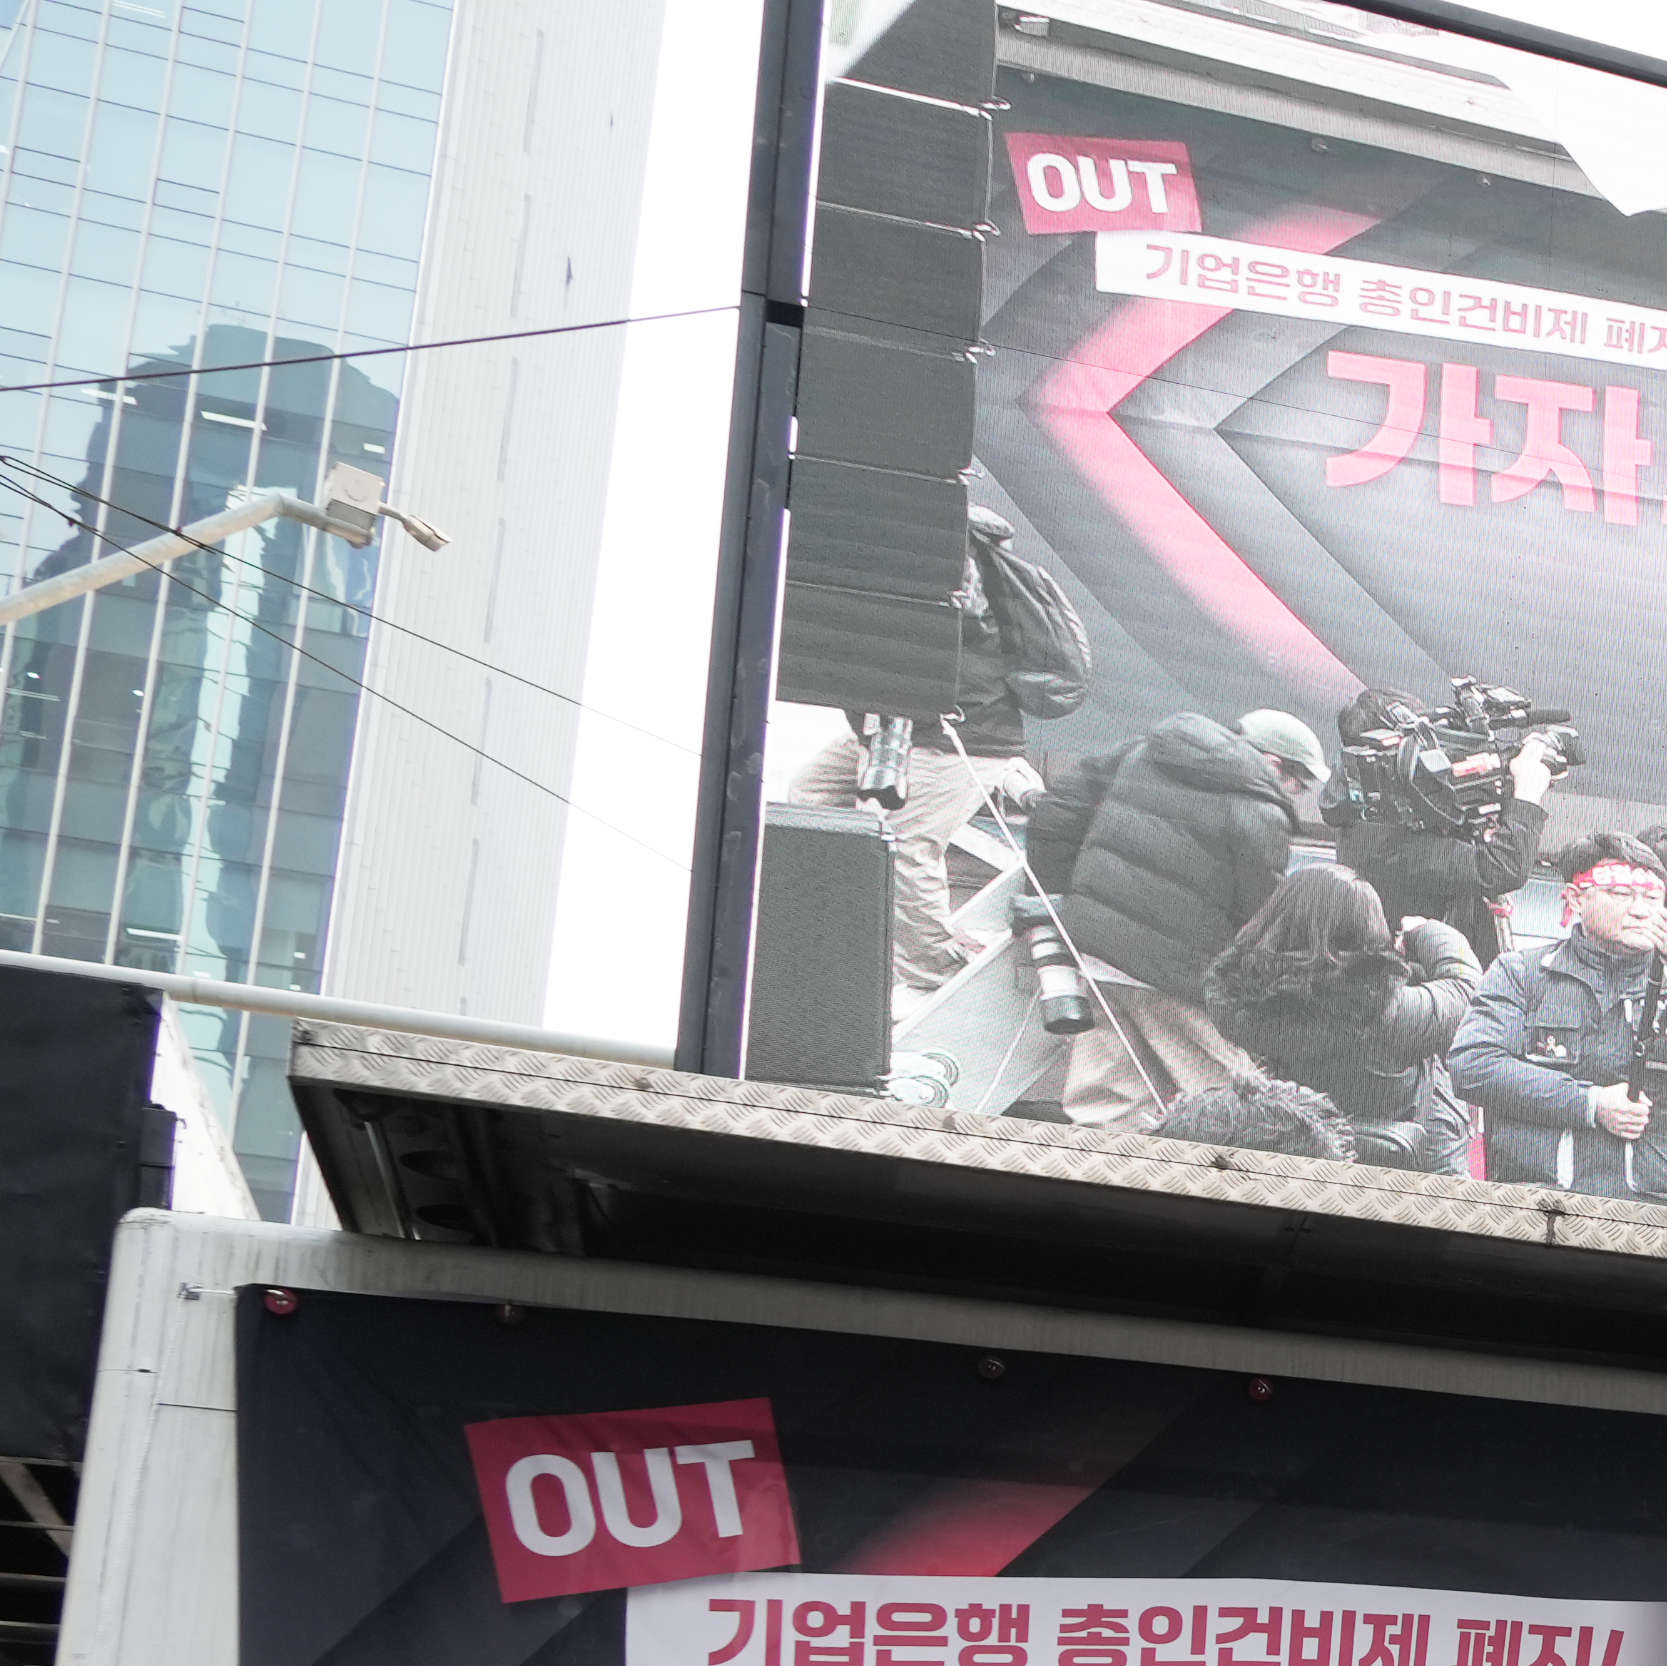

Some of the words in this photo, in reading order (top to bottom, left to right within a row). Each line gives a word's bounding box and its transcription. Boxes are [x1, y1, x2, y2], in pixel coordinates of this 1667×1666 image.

[1025, 150, 1178, 214] OUT
[1144, 243, 1342, 308] 기업은행
[1357, 275, 1590, 346] 총인건비제
[505, 1440, 755, 1557] OUT
